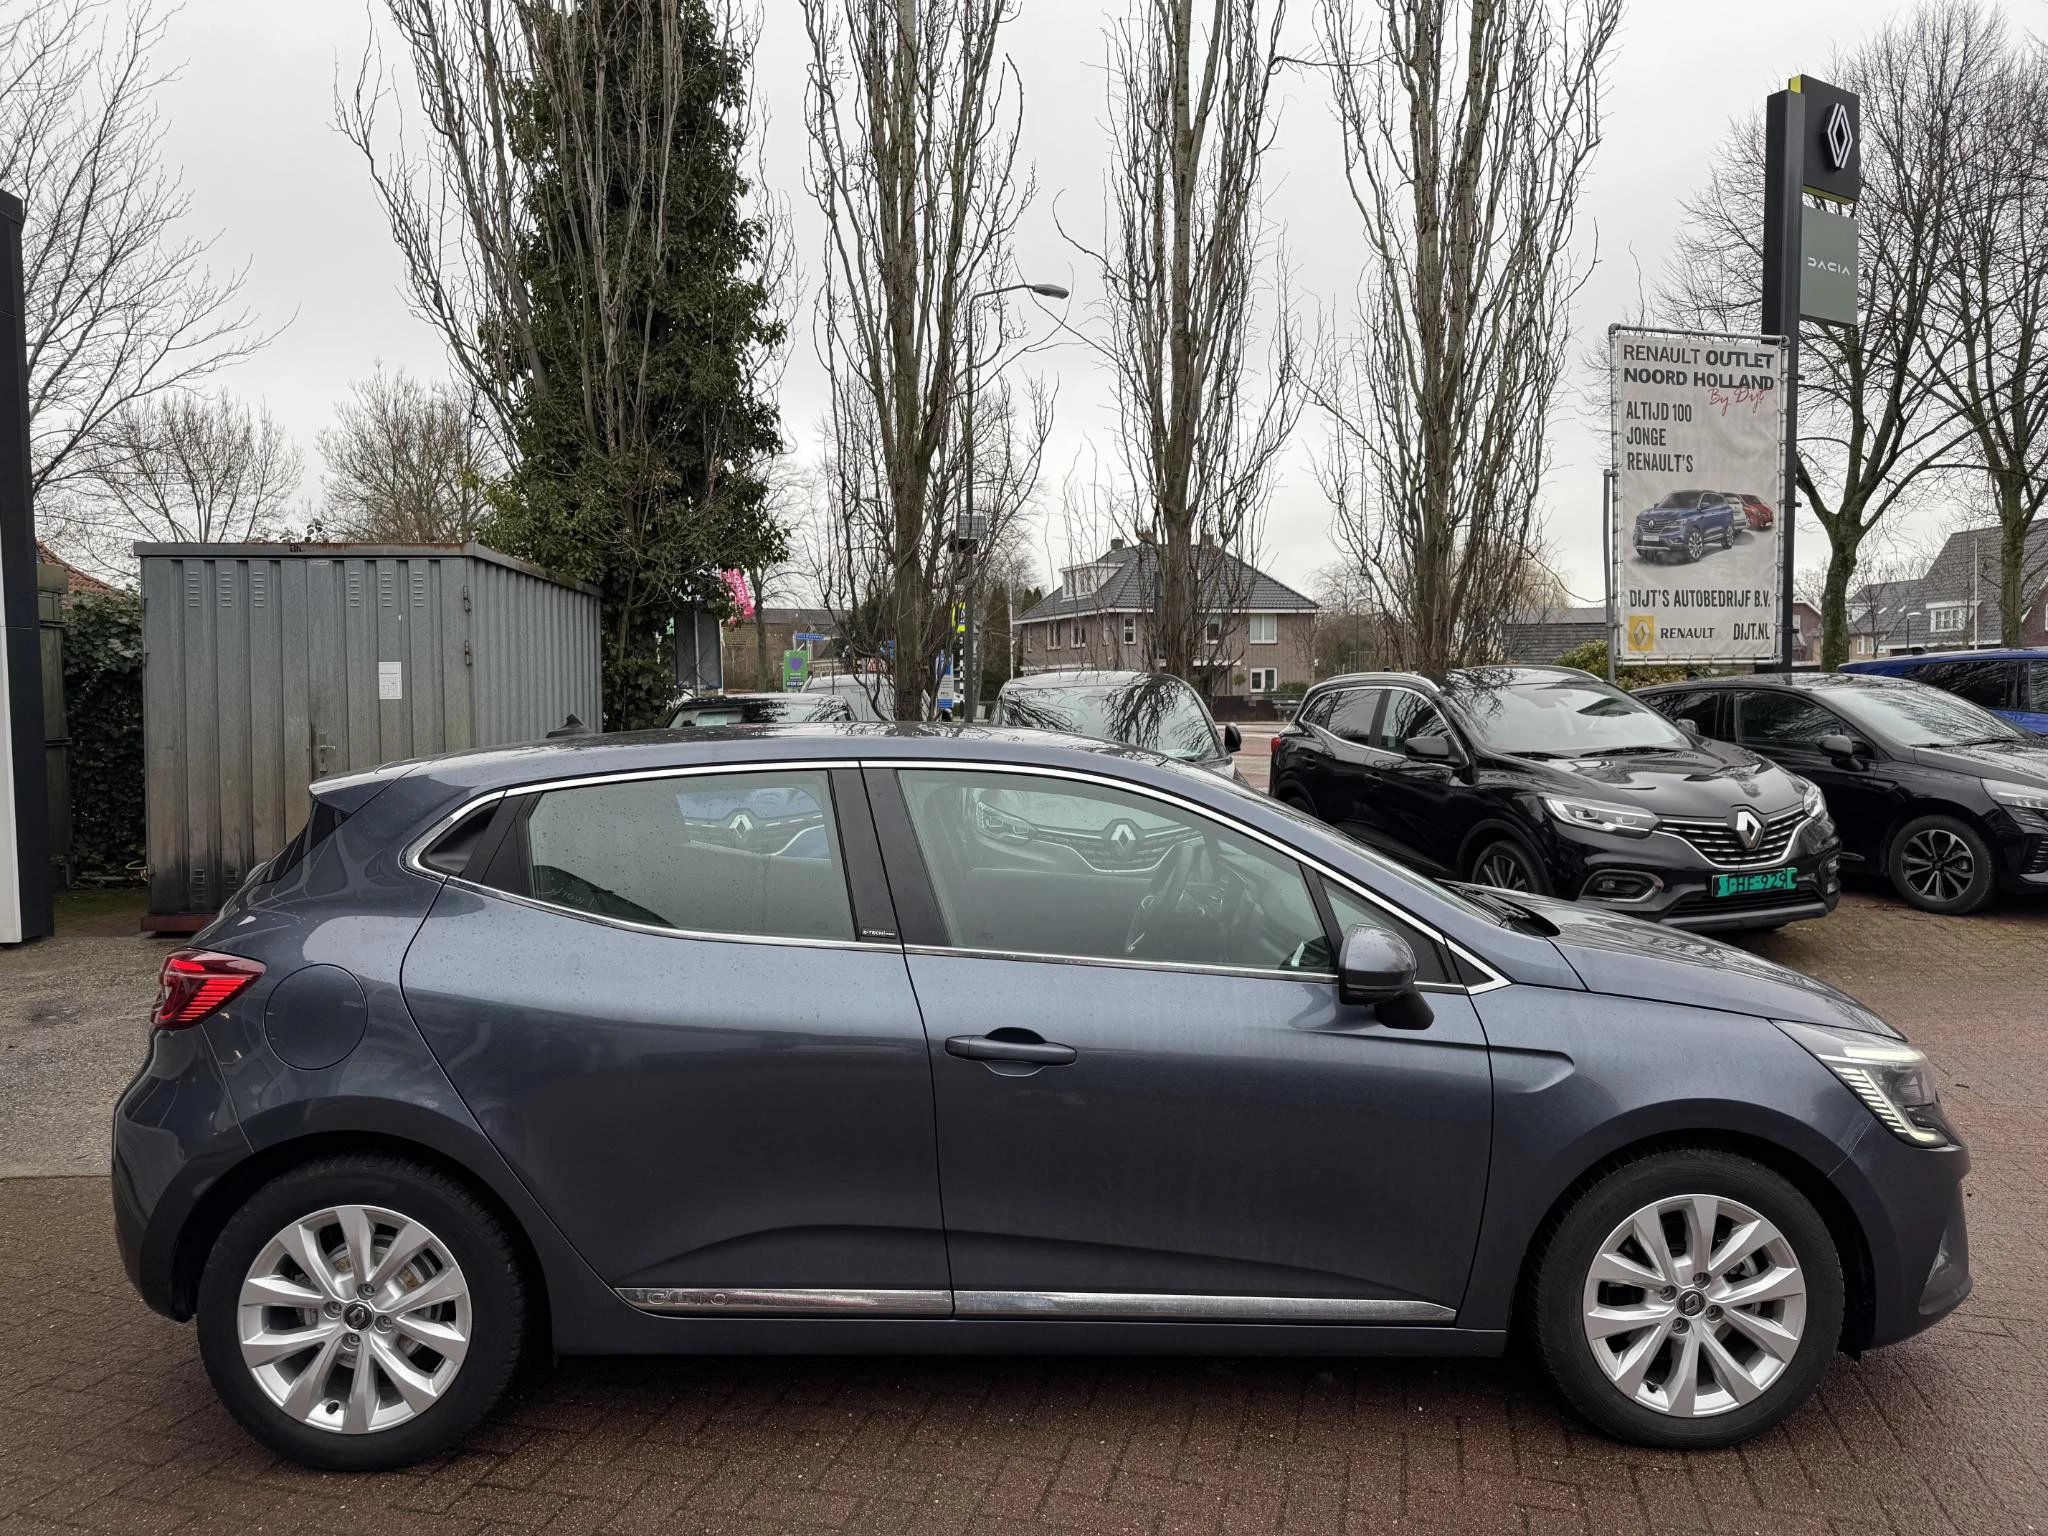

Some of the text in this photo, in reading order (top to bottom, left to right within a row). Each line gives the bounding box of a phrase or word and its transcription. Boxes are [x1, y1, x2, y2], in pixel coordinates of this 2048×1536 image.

[1807, 256, 1850, 276] DACIA
[1623, 344, 1774, 369] RENAULT OUTLET
[1623, 367, 1774, 390] NOORD HOLLAND
[1626, 401, 1692, 422] ALTIJD 100
[1708, 388, 1729, 416] By
[1626, 426, 1666, 446] JONGE
[1627, 452, 1694, 473] RENAULT'S
[1629, 589, 1771, 608] DIJT'S AUTOBEDRIJF B.V.
[1660, 622, 1771, 641] RENAULT DIJT.NL
